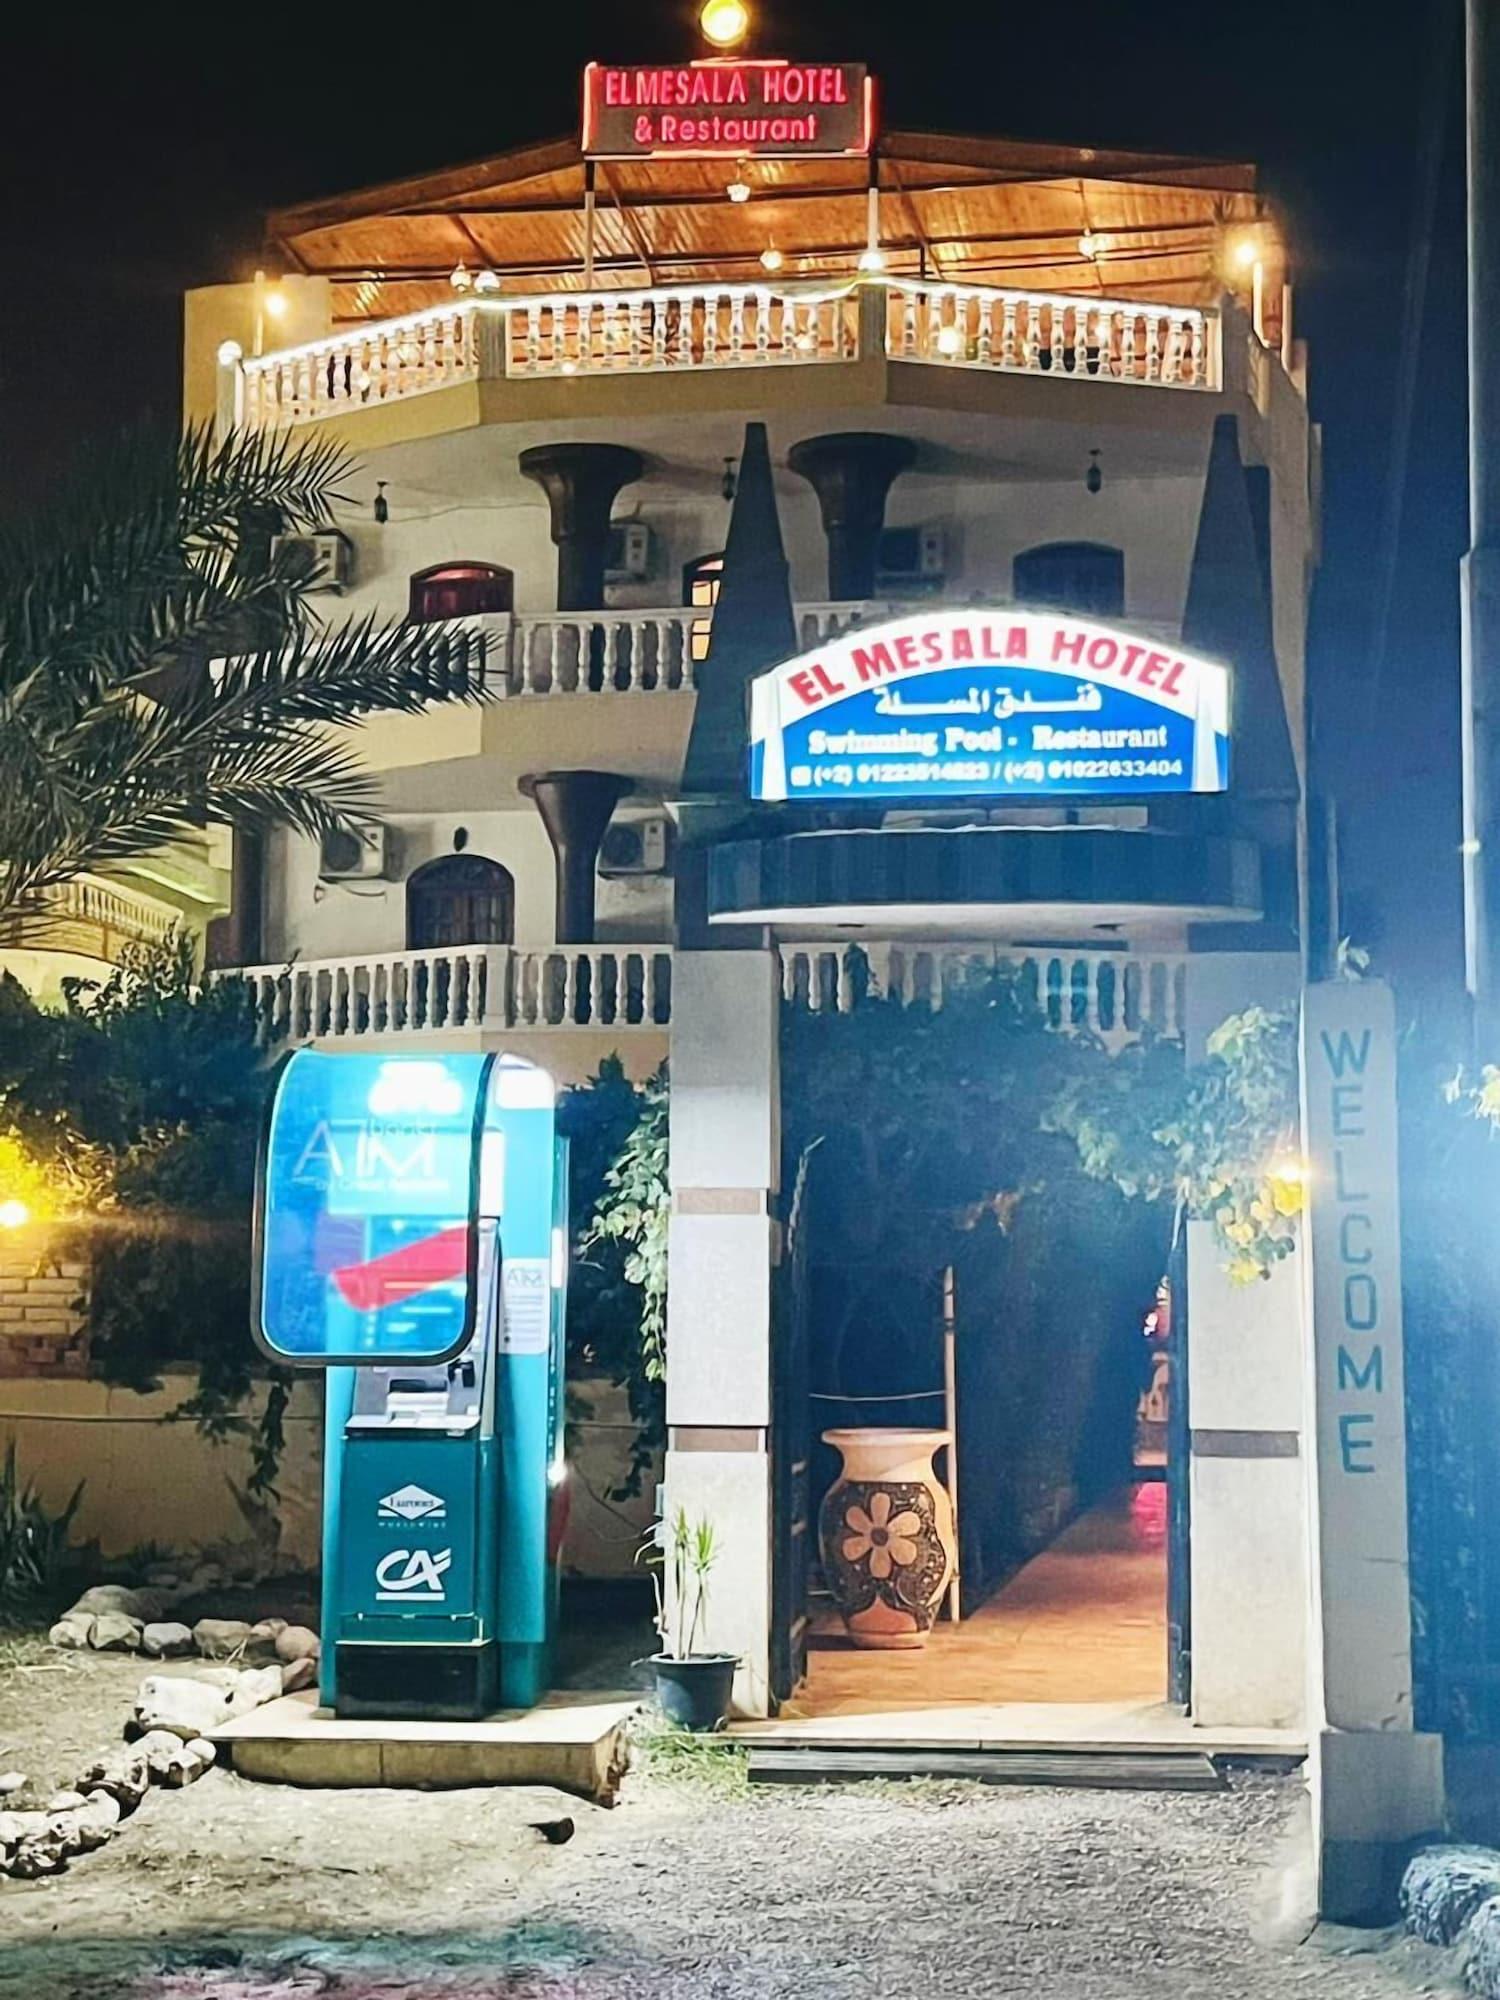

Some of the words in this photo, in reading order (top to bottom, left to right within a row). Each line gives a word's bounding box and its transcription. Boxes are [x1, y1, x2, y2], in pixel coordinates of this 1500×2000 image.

[762, 67, 847, 104] HOTEL
[634, 115, 653, 143] &
[660, 114, 817, 142] Restaurant
[788, 663, 845, 707] EL
[851, 626, 1029, 682] MESALA
[1051, 630, 1186, 697] HOTEL
[808, 728, 938, 757] Swimming
[944, 726, 1003, 752] Pool
[1031, 724, 1168, 751] Restaurant
[293, 1119, 436, 1177] ATM
[1320, 1028, 1383, 1474] WELCOME
[375, 1548, 452, 1591] CA
